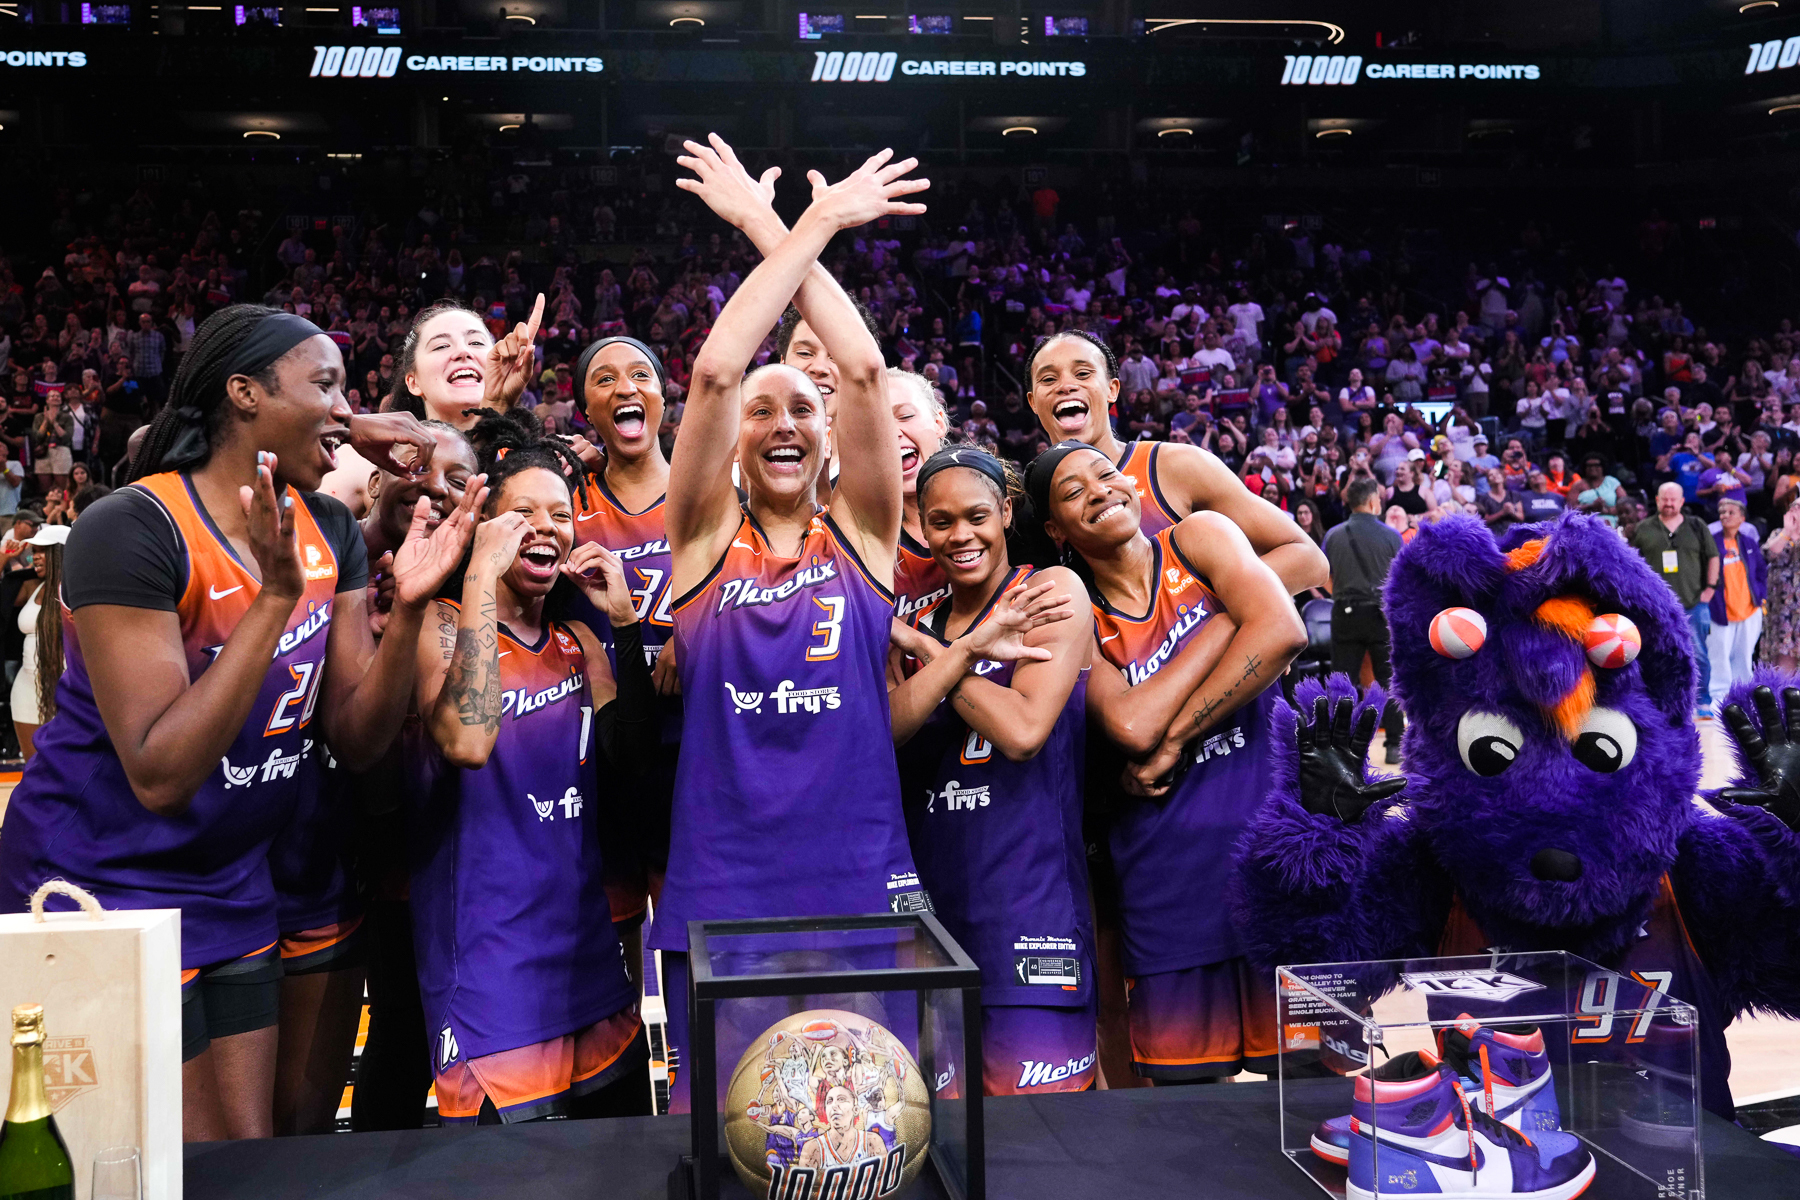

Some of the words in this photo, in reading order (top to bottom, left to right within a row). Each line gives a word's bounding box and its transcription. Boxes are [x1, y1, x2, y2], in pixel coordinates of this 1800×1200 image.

[310, 46, 402, 78] 10000
[406, 55, 508, 72] CAREER
[512, 56, 604, 73] POINTS
[810, 52, 897, 82] 10000
[901, 60, 996, 76] CAREER
[1000, 60, 1086, 77] POINTS
[1280, 55, 1363, 85] 10000
[1366, 64, 1455, 79] CAREER
[1459, 65, 1540, 80] POINTS
[1745, 36, 1800, 75] 100
[305, 566, 333, 578] PayPal
[717, 558, 838, 612] Phoenix
[1169, 574, 1194, 595] PayPal
[806, 595, 845, 661] 3
[769, 680, 841, 715] fry's
[939, 780, 990, 811] fry's
[1571, 970, 1673, 1044] 97
[1457, 1087, 1472, 1120] WHITE
[1468, 1122, 1476, 1161] MAMBA
